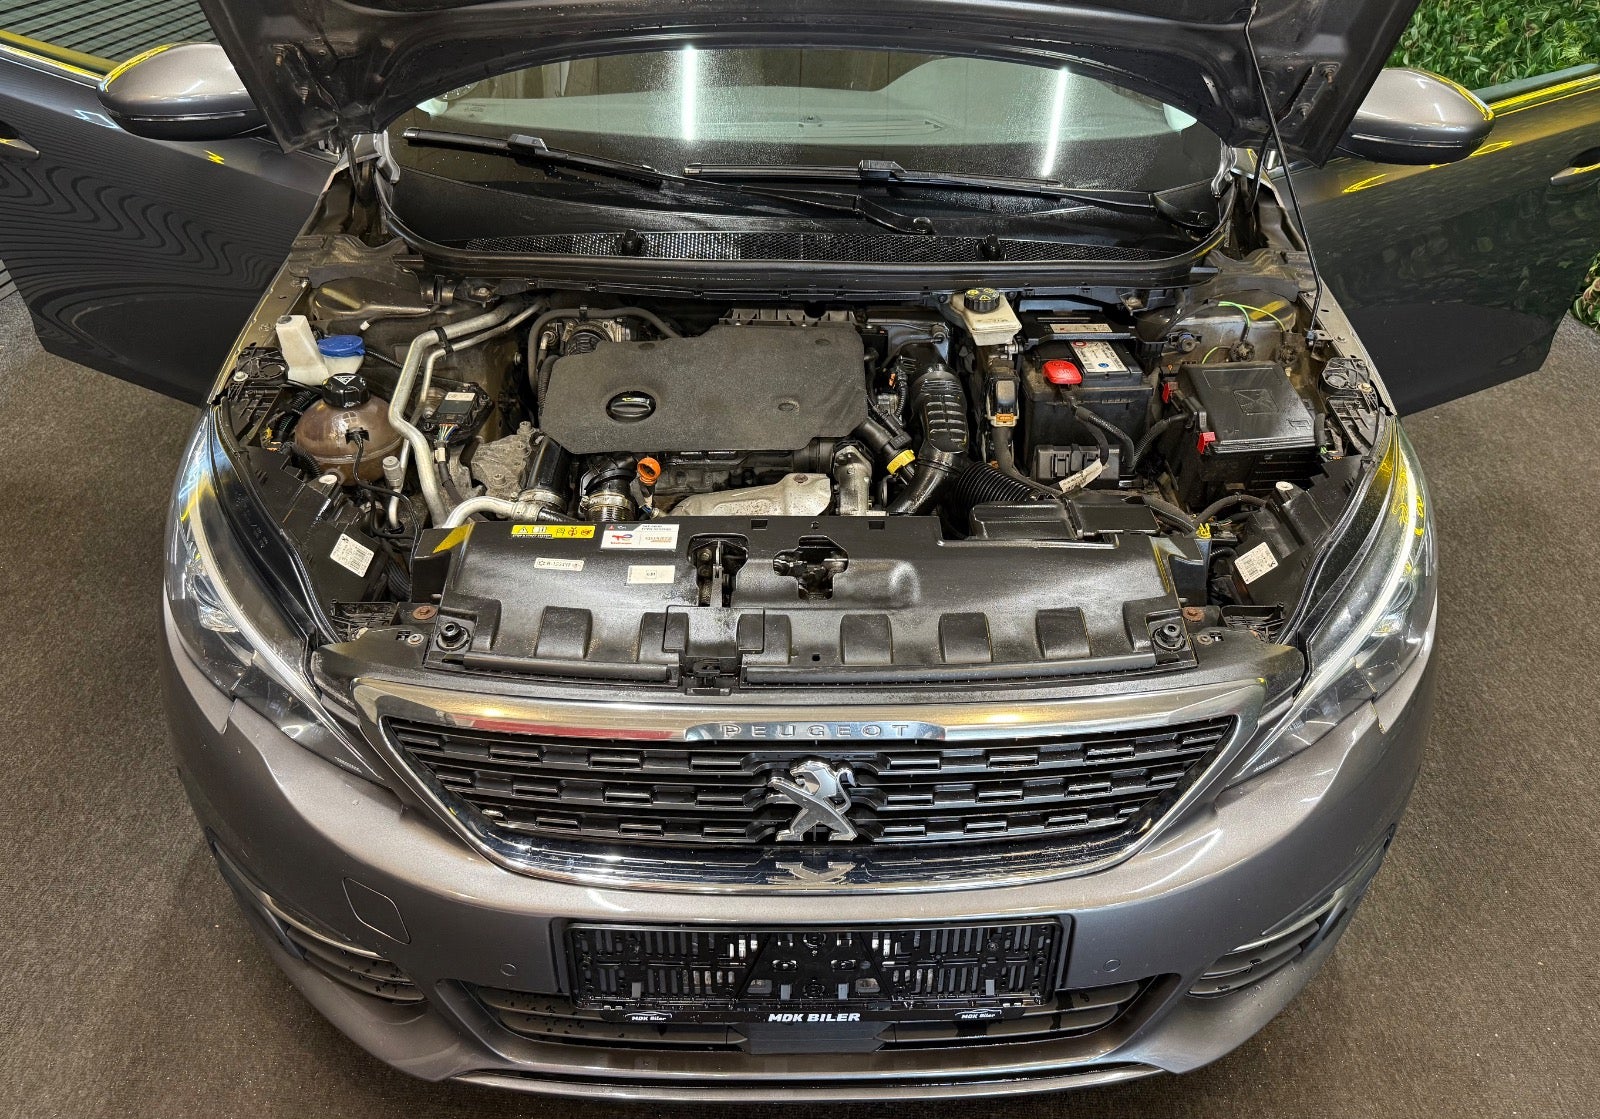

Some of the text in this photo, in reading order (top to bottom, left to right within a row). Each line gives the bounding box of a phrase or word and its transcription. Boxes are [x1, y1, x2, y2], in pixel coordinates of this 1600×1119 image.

[721, 724, 909, 737] PEUGEOT
[768, 1012, 861, 1022] MDK BILER
